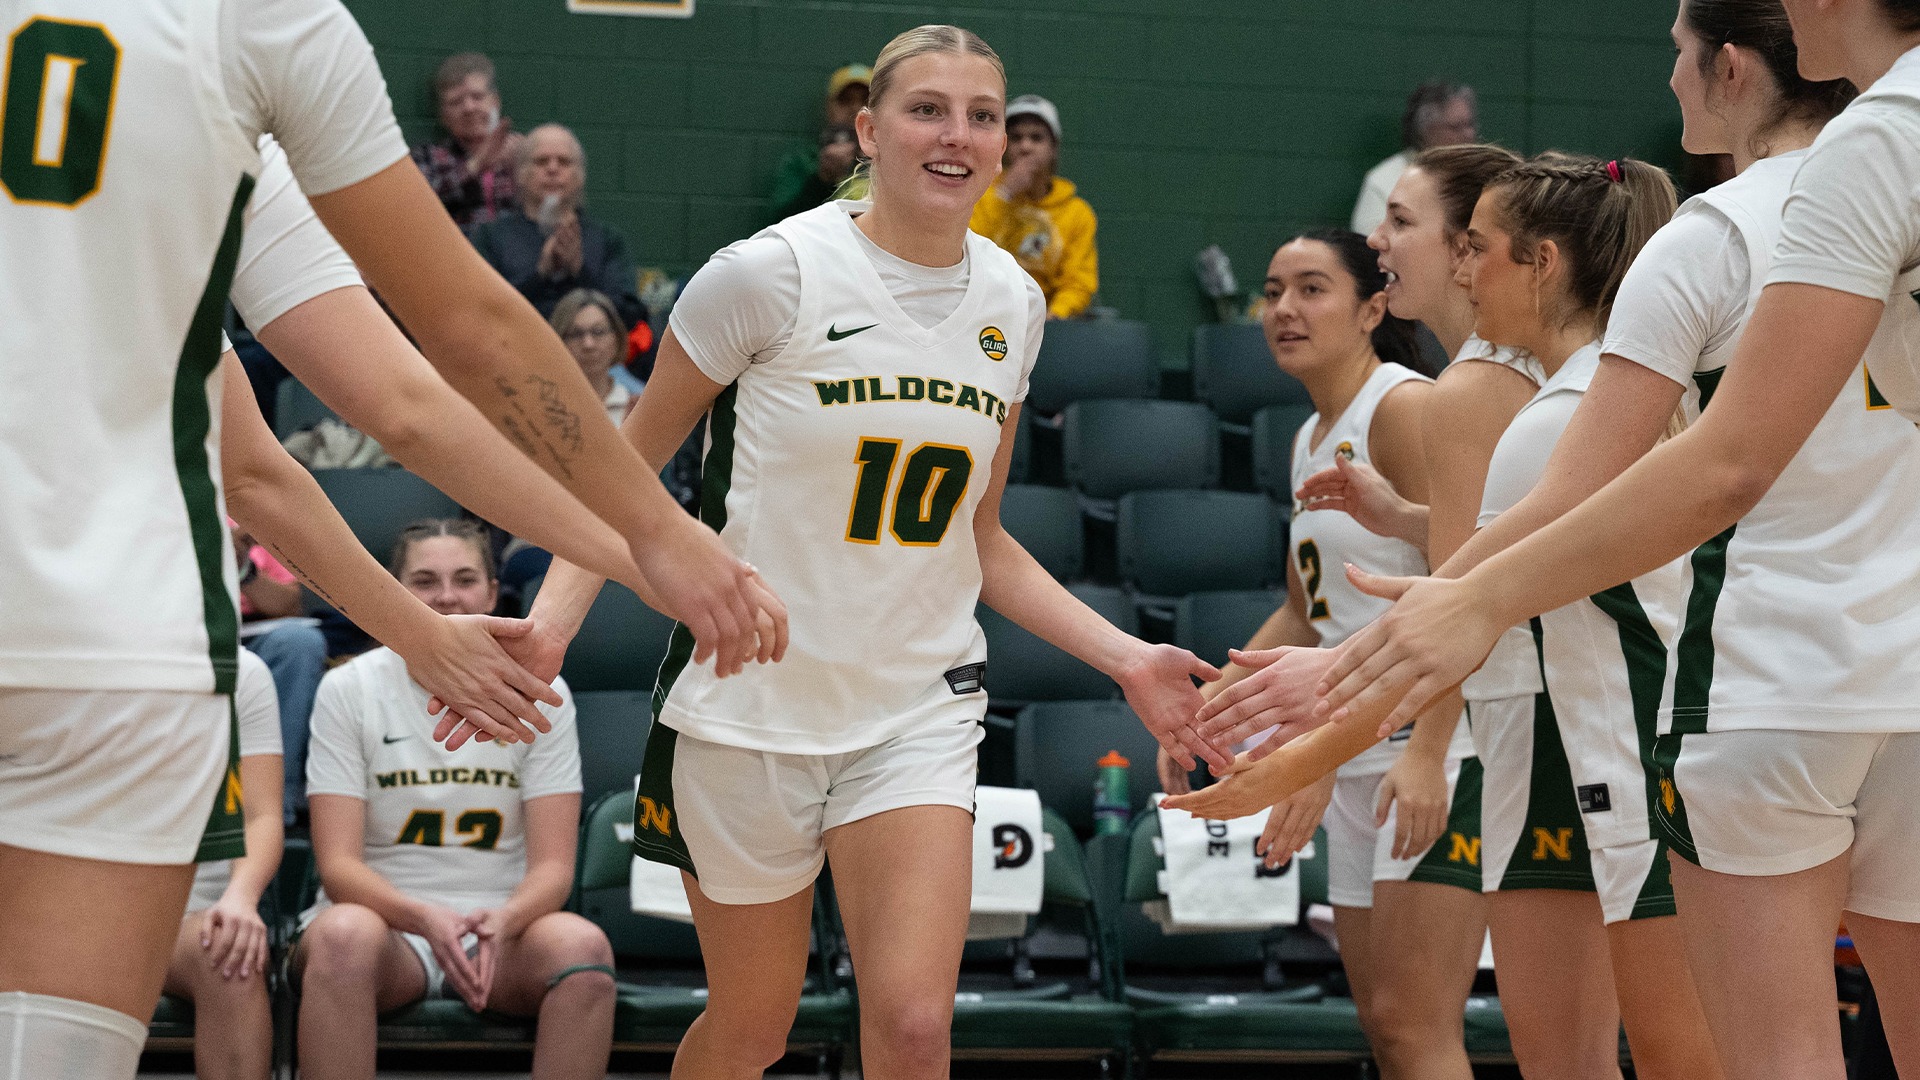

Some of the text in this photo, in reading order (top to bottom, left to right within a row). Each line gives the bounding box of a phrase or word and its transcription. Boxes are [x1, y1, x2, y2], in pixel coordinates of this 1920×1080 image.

[0, 13, 124, 210] 0
[983, 340, 1007, 352] GLIAC
[811, 375, 1009, 427] WILDCATS
[844, 436, 975, 547] 10
[1298, 537, 1331, 621] 2
[375, 767, 521, 789] WILDCATS
[1594, 792, 1604, 803] M
[395, 808, 504, 850] 42
[639, 795, 672, 838] N
[1448, 832, 1482, 866] N
[1532, 827, 1573, 860] N
